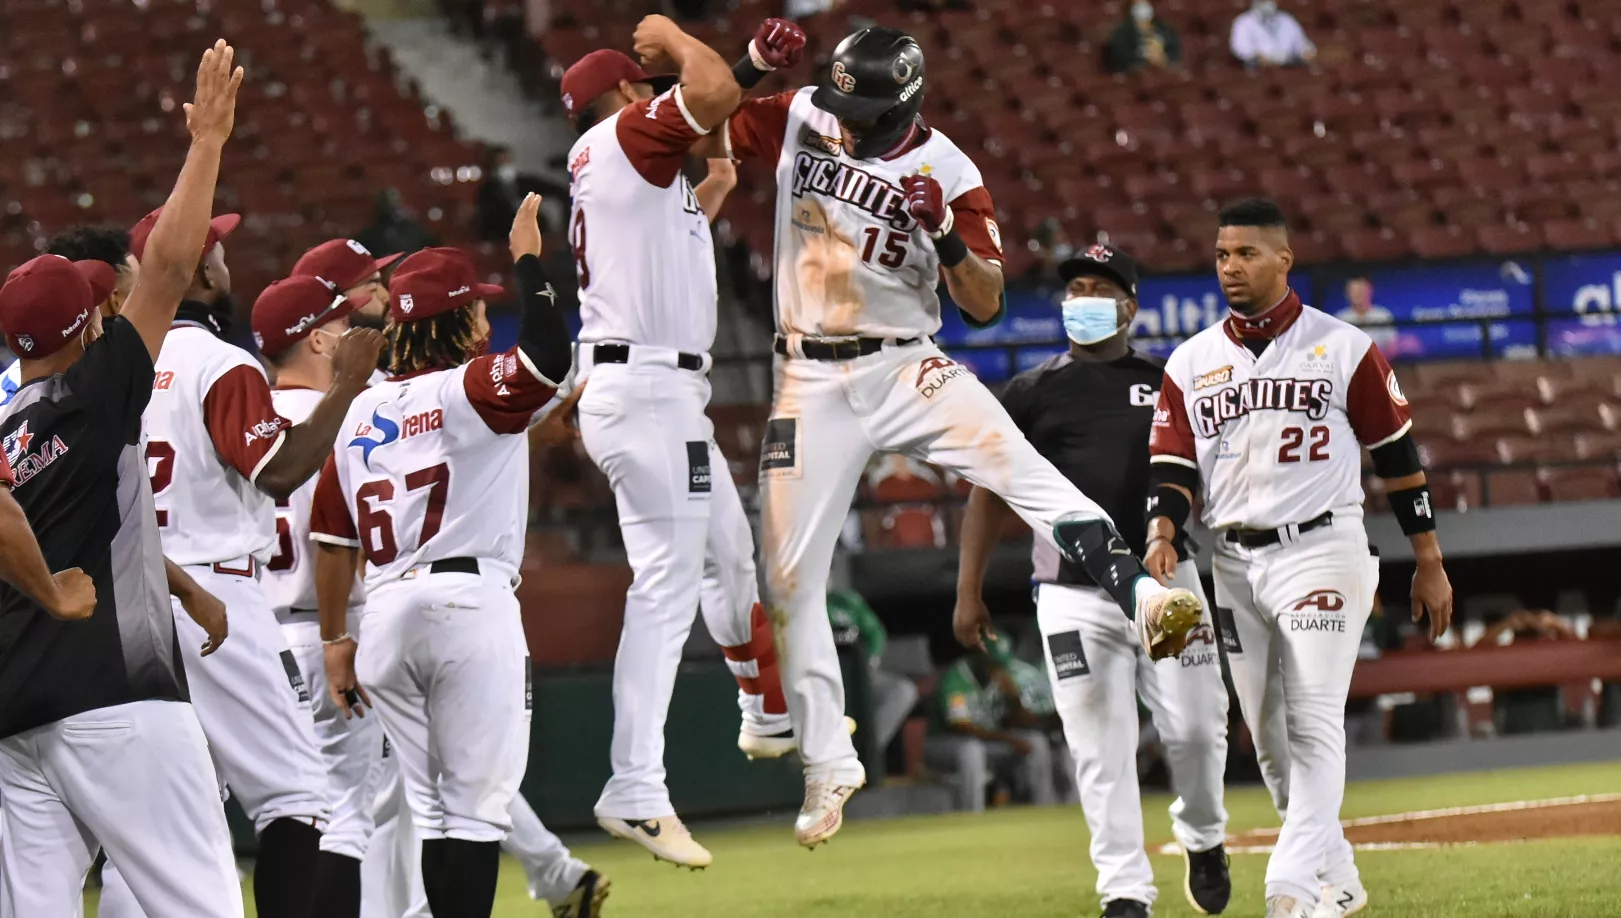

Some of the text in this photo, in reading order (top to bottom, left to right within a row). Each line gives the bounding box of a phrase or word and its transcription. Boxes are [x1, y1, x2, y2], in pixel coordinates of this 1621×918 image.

[793, 151, 919, 233] GIGANTES
[862, 226, 909, 268] 15
[1193, 377, 1334, 439] GIGANTES
[1278, 425, 1330, 463] 22
[356, 461, 450, 567] 67
[1291, 619, 1346, 633] DUARTE
